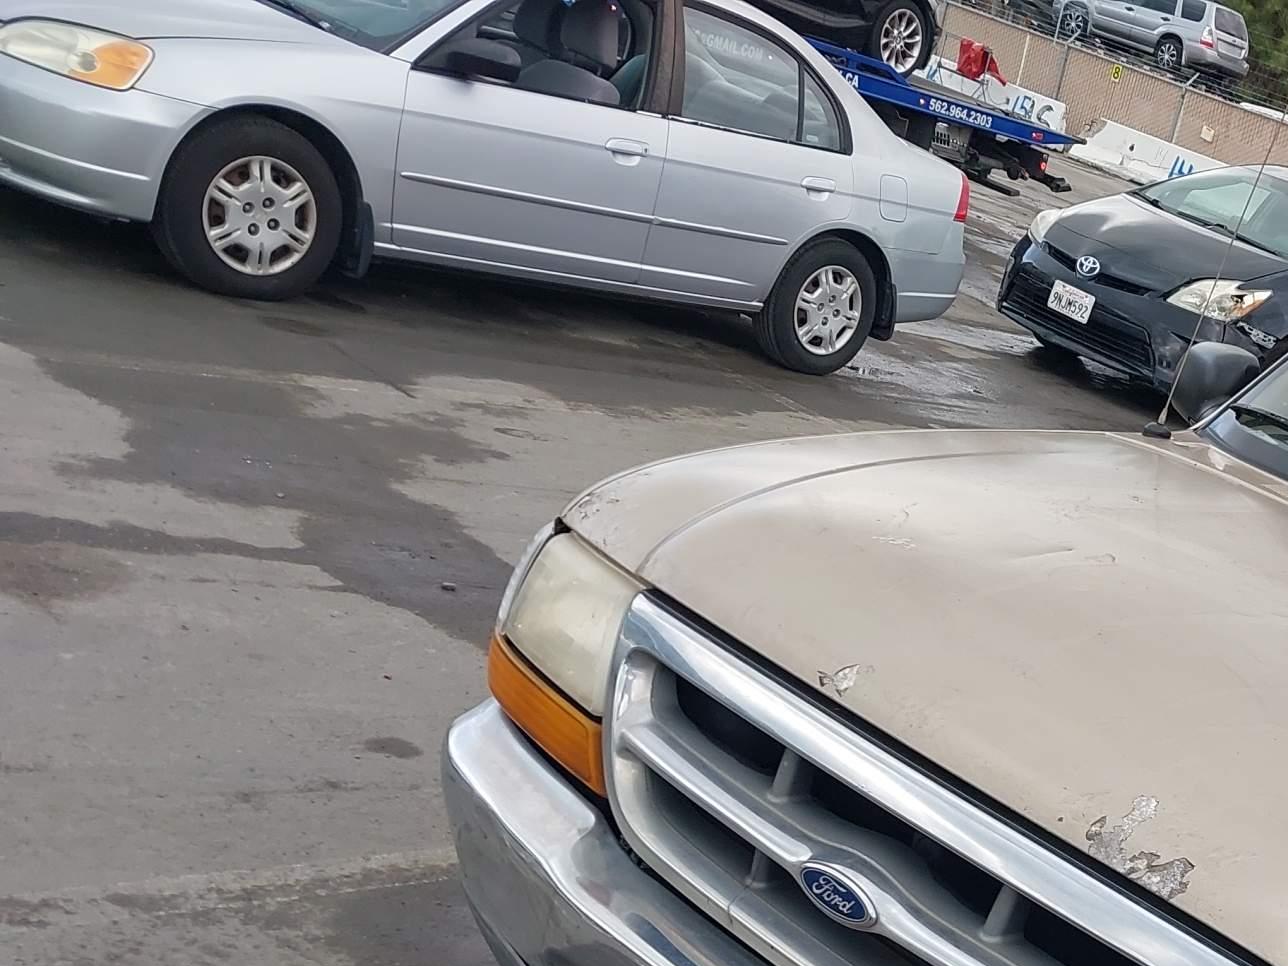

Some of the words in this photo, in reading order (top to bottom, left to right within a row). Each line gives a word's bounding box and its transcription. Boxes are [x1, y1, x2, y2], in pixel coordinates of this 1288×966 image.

[1112, 66, 1121, 80] 8
[929, 98, 993, 128] 562.964.2303
[1050, 291, 1089, 320] 9NJM592
[812, 875, 856, 914] Ford
